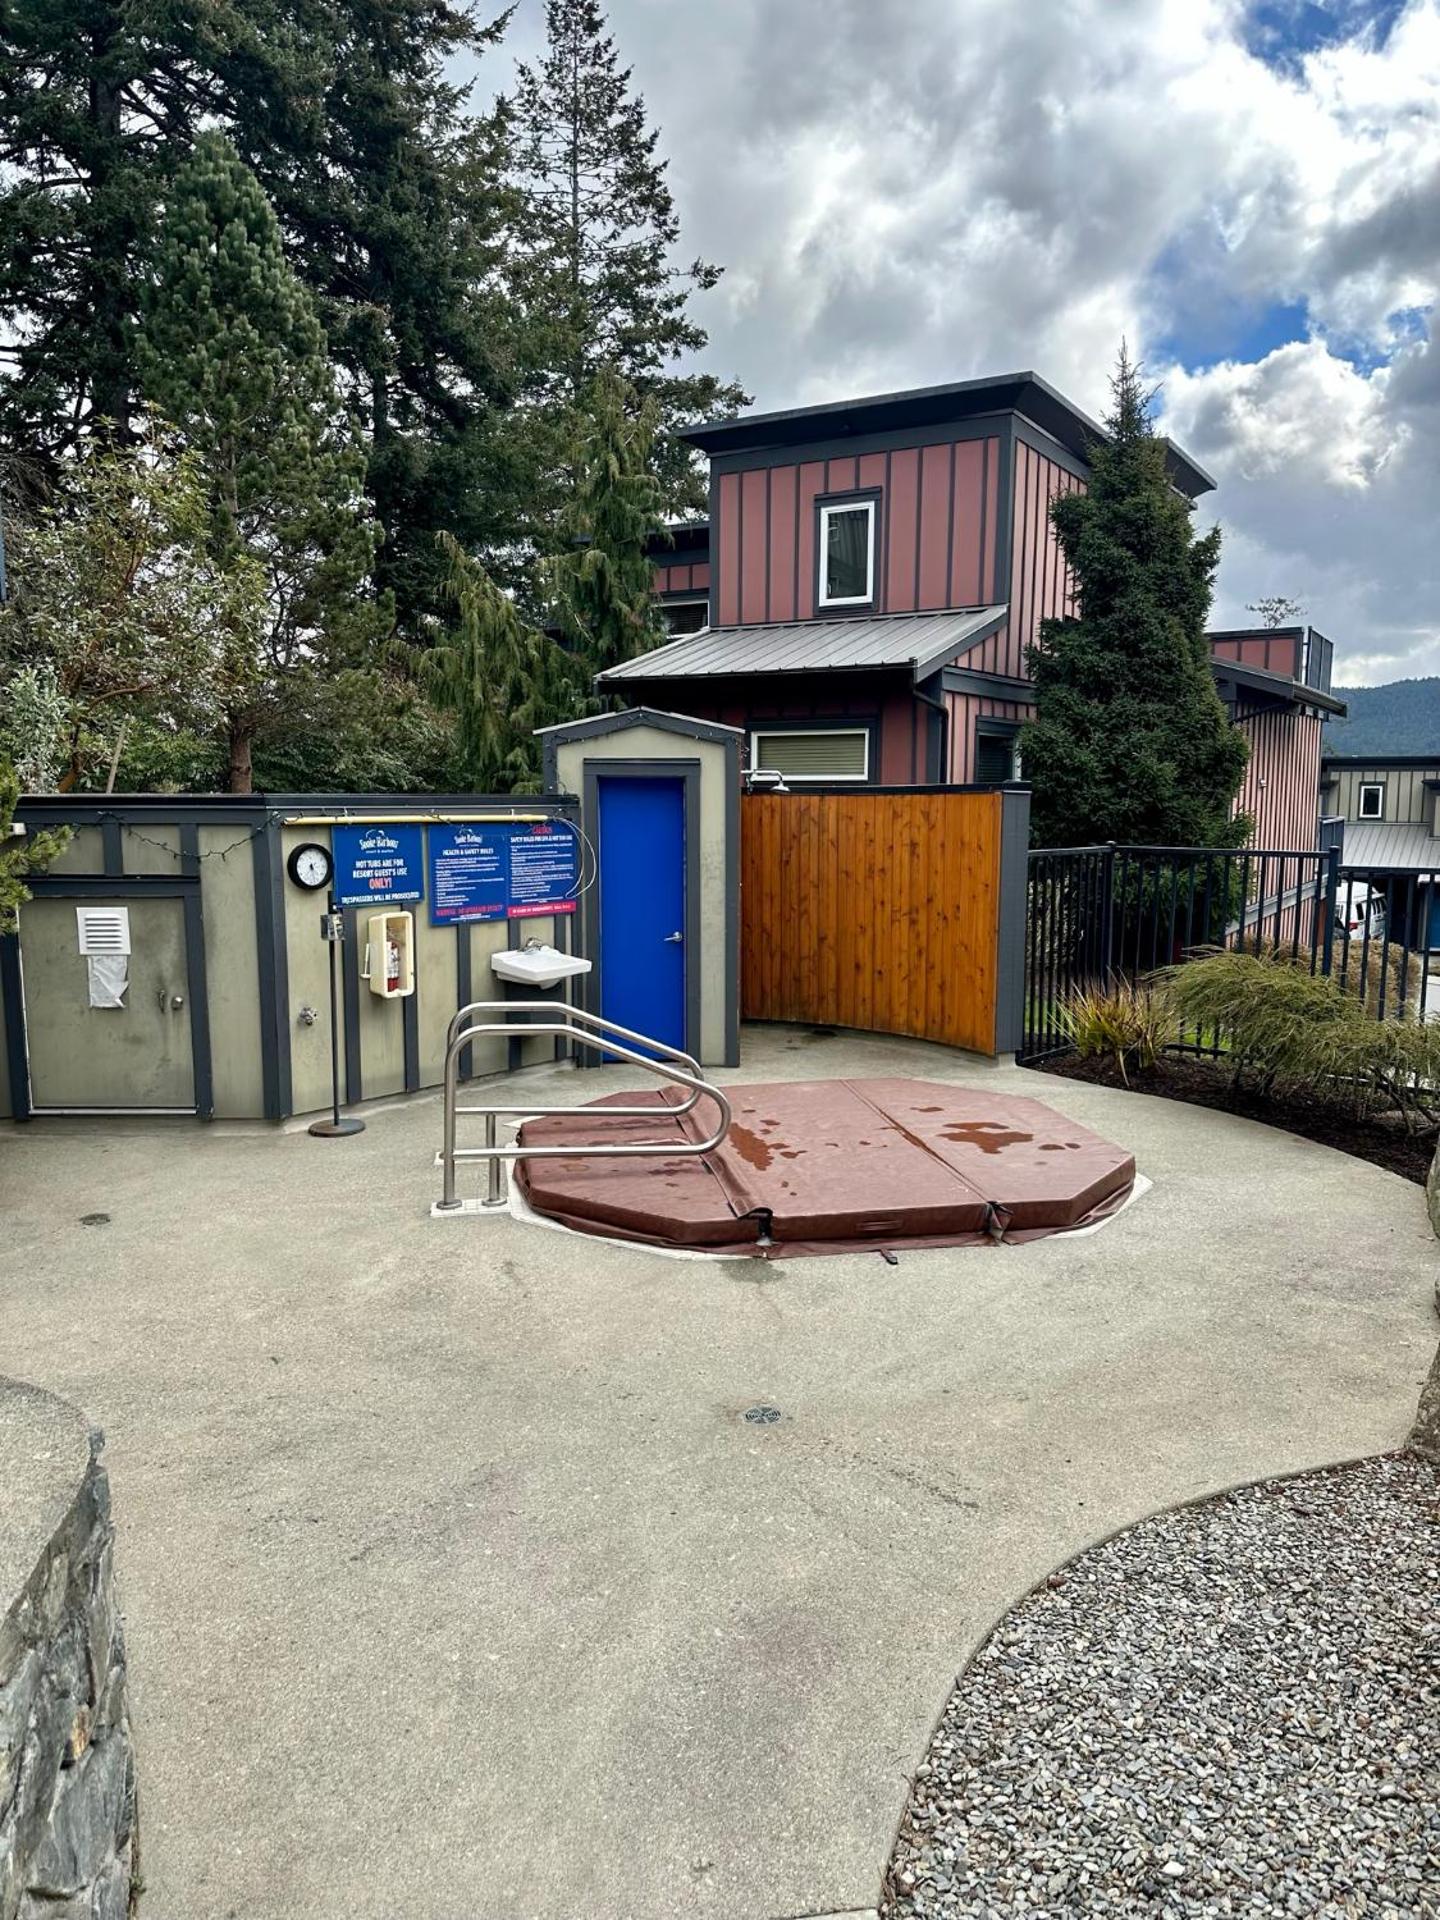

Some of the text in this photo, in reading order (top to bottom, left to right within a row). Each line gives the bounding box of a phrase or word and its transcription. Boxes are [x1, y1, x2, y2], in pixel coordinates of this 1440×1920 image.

[355, 858, 404, 868] HOT TUBS ARE FOR
[353, 869, 374, 878] RESORT
[397, 867, 408, 876] USE
[369, 877, 392, 890] ONLY!
[341, 895, 373, 904] TRESPASSERS
[374, 894, 384, 902] WILL
